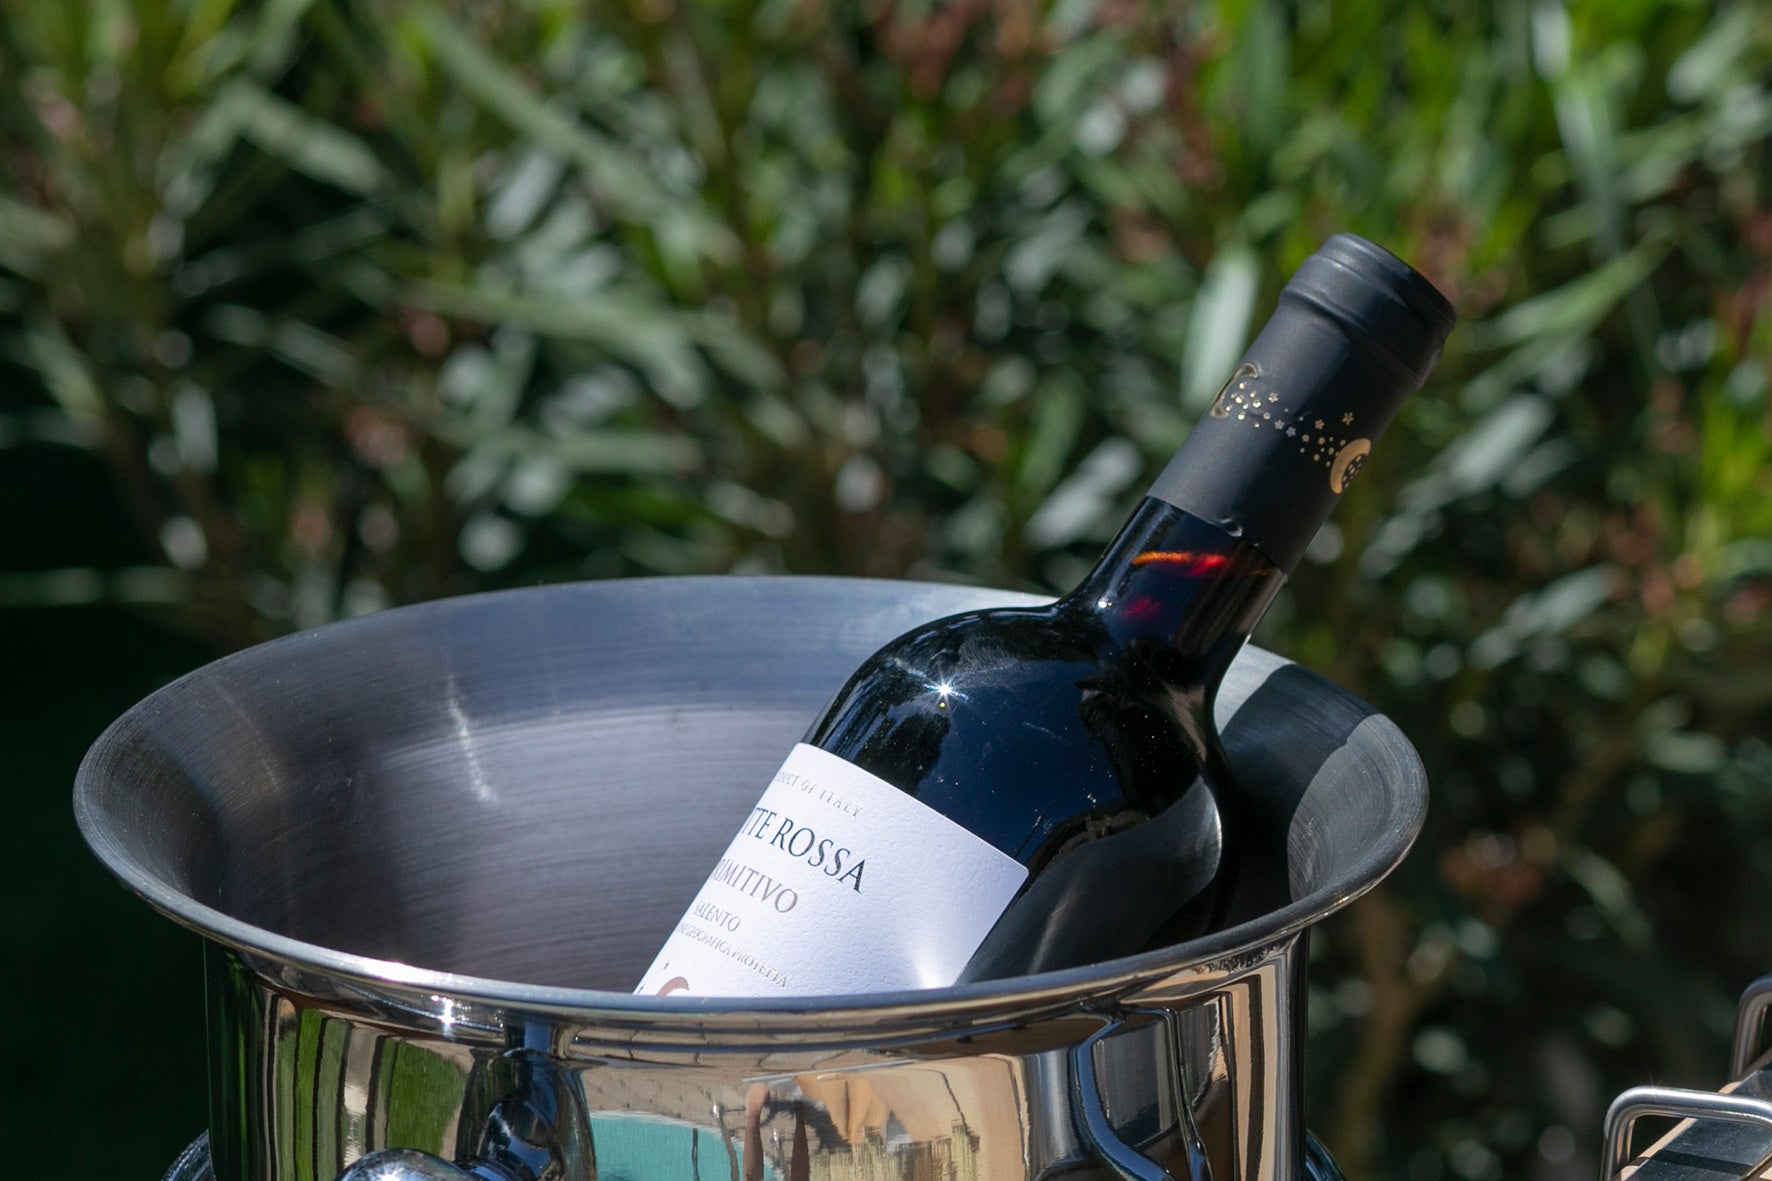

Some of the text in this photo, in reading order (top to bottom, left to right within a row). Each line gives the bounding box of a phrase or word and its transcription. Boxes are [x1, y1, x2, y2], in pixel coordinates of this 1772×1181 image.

[819, 788, 864, 817] ITALY
[768, 817, 867, 895] ROSSA
[731, 948, 789, 987] PROTETTA
